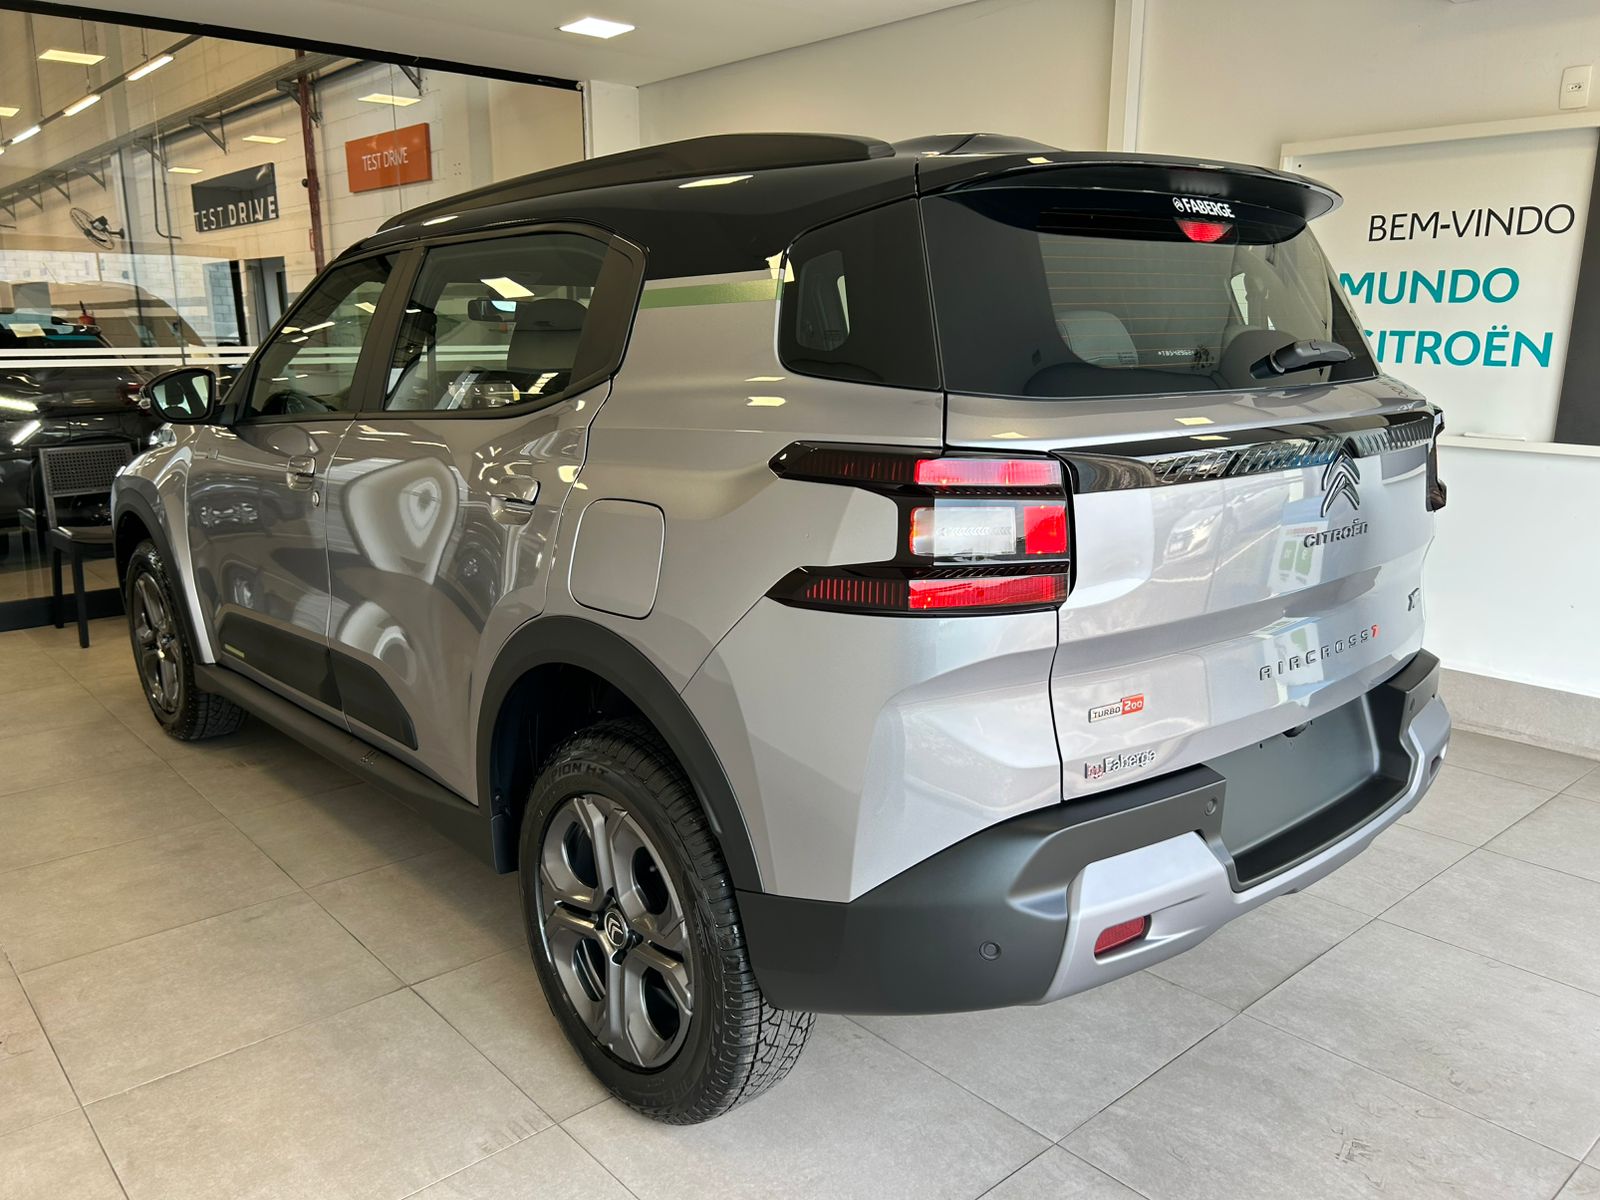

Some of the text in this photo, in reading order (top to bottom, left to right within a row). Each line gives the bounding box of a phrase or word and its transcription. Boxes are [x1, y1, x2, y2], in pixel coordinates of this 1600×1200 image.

[362, 147, 408, 171] TEST DRIVE
[194, 196, 276, 231] TEST DRIVE
[1181, 197, 1236, 218] FABERGE
[1367, 203, 1576, 242] BEM-VINDO
[1339, 267, 1520, 305] MUNDO
[1363, 324, 1554, 368] ITROËN
[1094, 700, 1143, 719] TURBO 200
